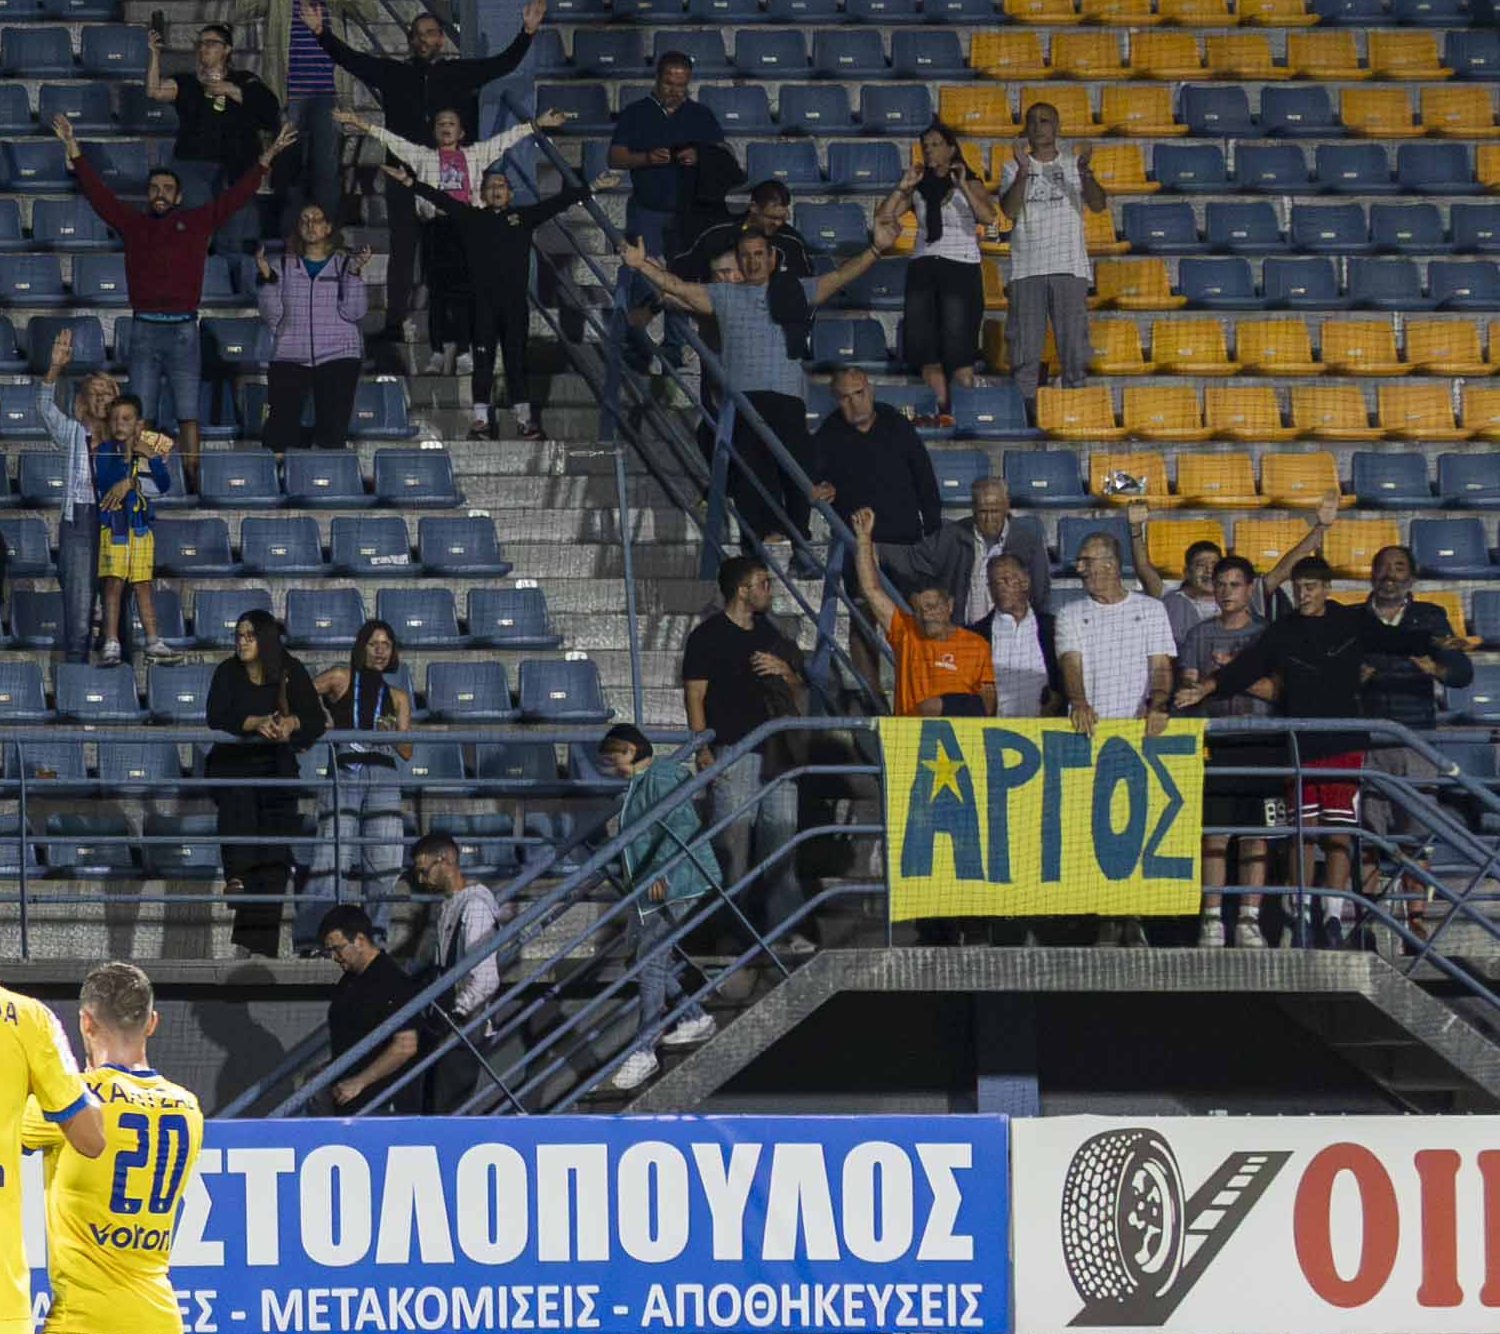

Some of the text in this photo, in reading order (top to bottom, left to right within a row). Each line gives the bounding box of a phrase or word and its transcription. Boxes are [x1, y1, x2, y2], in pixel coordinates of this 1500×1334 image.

[900, 719, 1197, 883] ΑΡΓΟΣ
[109, 1112, 190, 1214] 20
[173, 1141, 974, 1266] ΣΤΟΛΟΠΟΥΛΟΣ
[1292, 1141, 1500, 1309] ΟΙ
[261, 1285, 601, 1332] ΜΕΤΑΚΟΜΙΣΕΙΣ
[643, 1282, 984, 1329] ΑΠΟΘΗΚΕΥΣΕΙΣ
